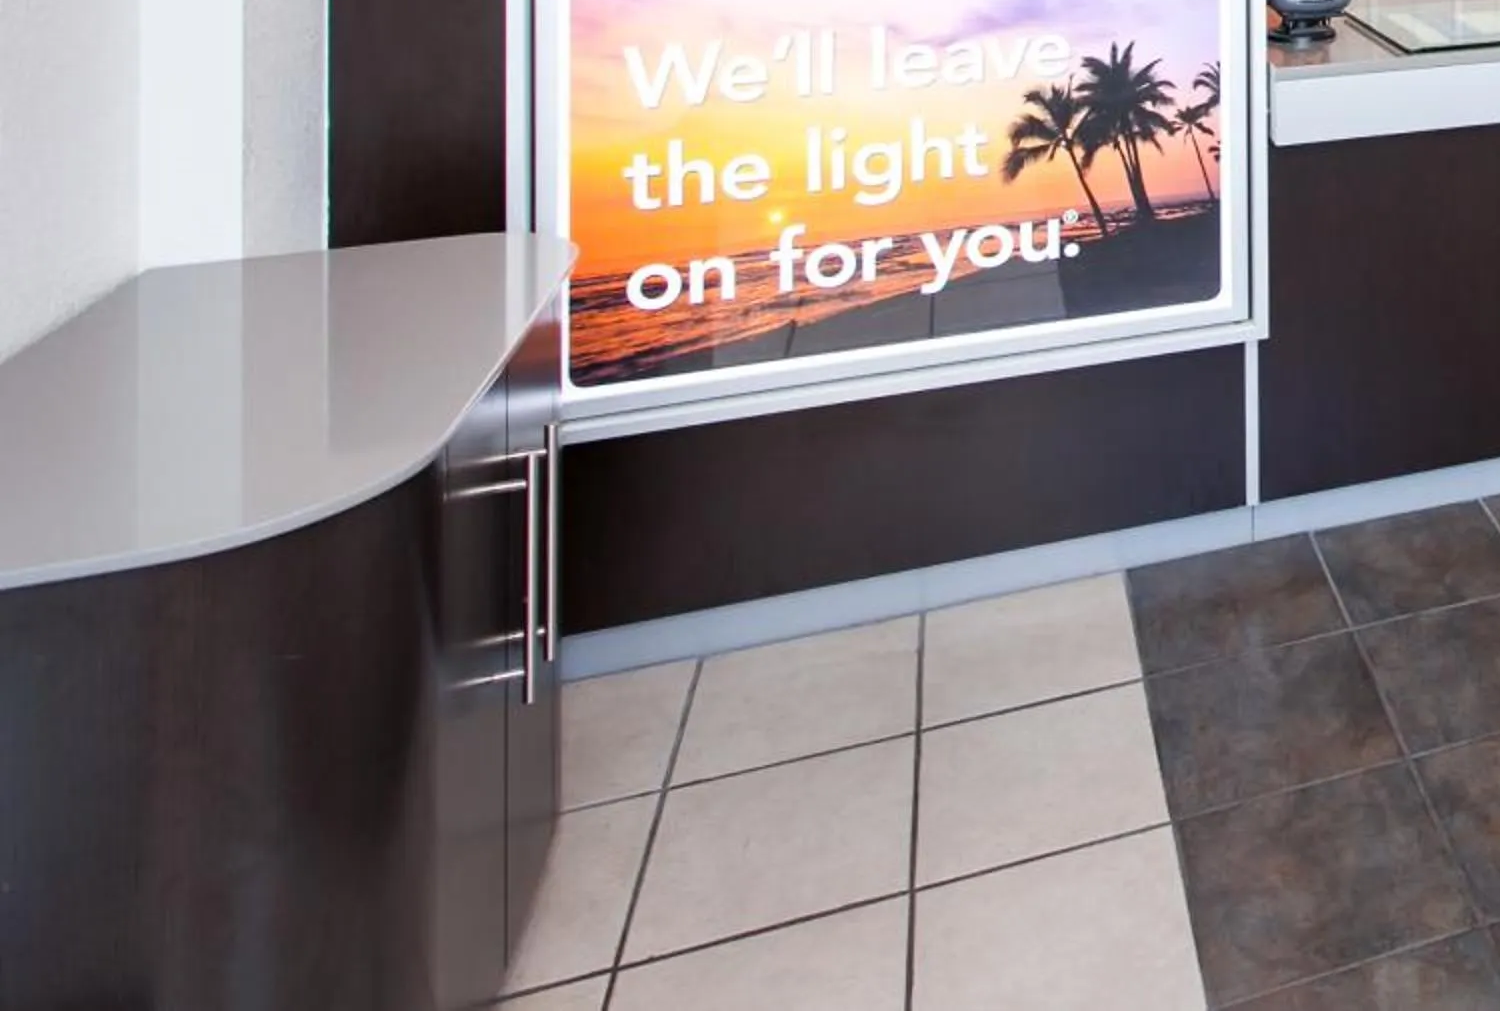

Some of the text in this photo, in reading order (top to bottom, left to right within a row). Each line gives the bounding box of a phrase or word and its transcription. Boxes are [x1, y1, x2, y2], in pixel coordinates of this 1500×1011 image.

[622, 25, 1073, 110] We'll leave
[622, 117, 989, 211] the light
[626, 253, 736, 311] on
[769, 224, 893, 291] for
